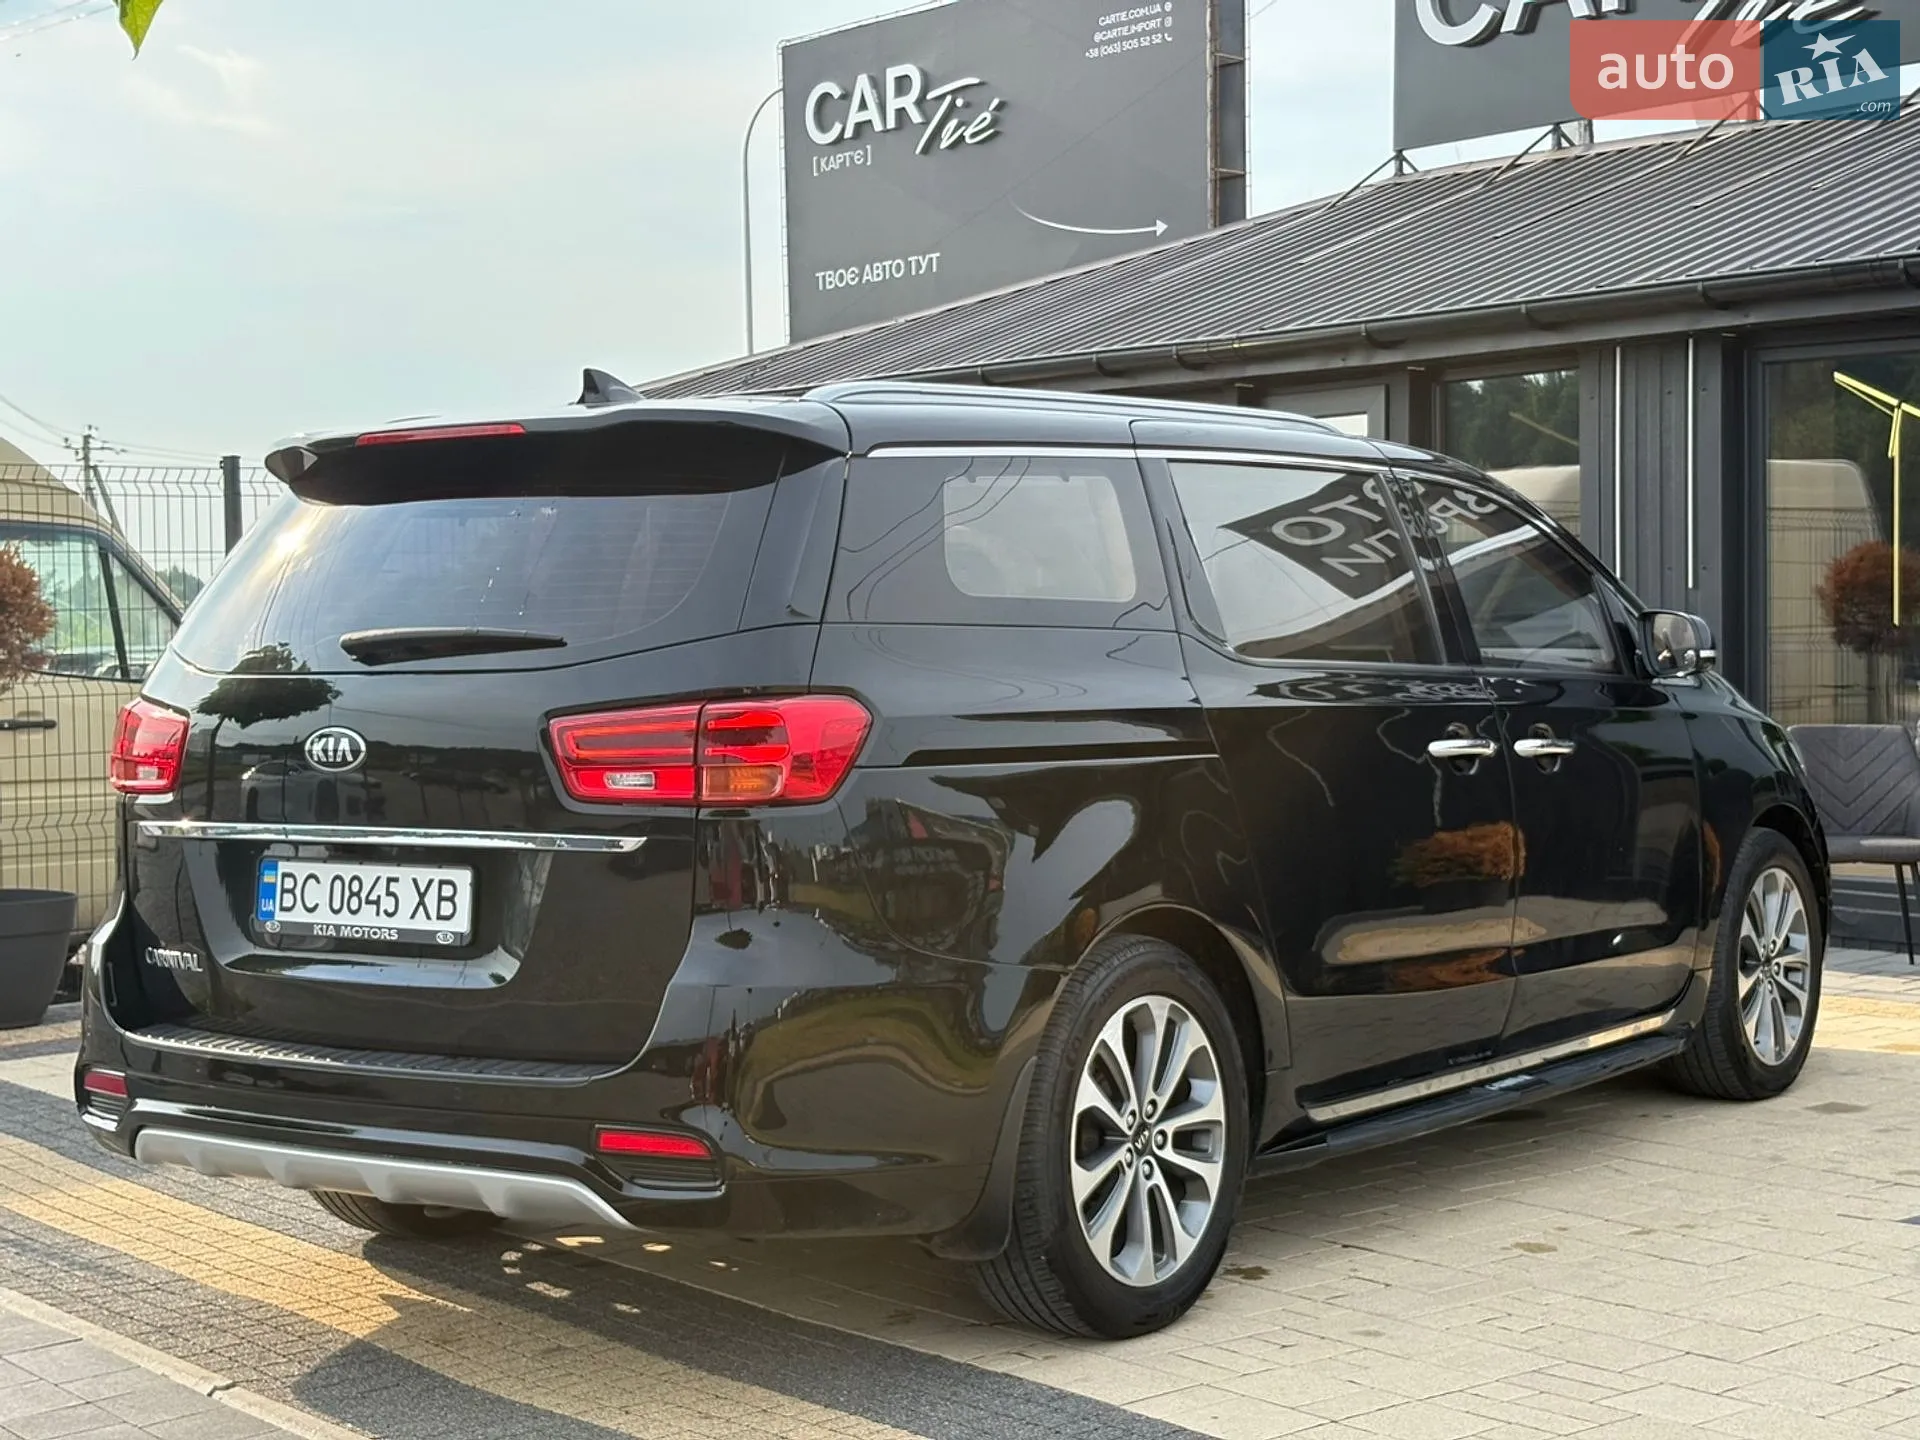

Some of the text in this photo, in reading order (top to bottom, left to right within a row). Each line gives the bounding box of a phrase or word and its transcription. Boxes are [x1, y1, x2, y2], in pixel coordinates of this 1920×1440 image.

[1122, 38, 1139, 51] 505
[1140, 36, 1150, 47] 52
[1152, 33, 1162, 44] 52
[815, 252, 940, 291] ТВОЄ АВТО ТУТ
[312, 736, 354, 763] KIA
[261, 897, 275, 912] UA
[279, 871, 458, 921] BC 0845 XB
[312, 923, 399, 941] KIA MOTORS
